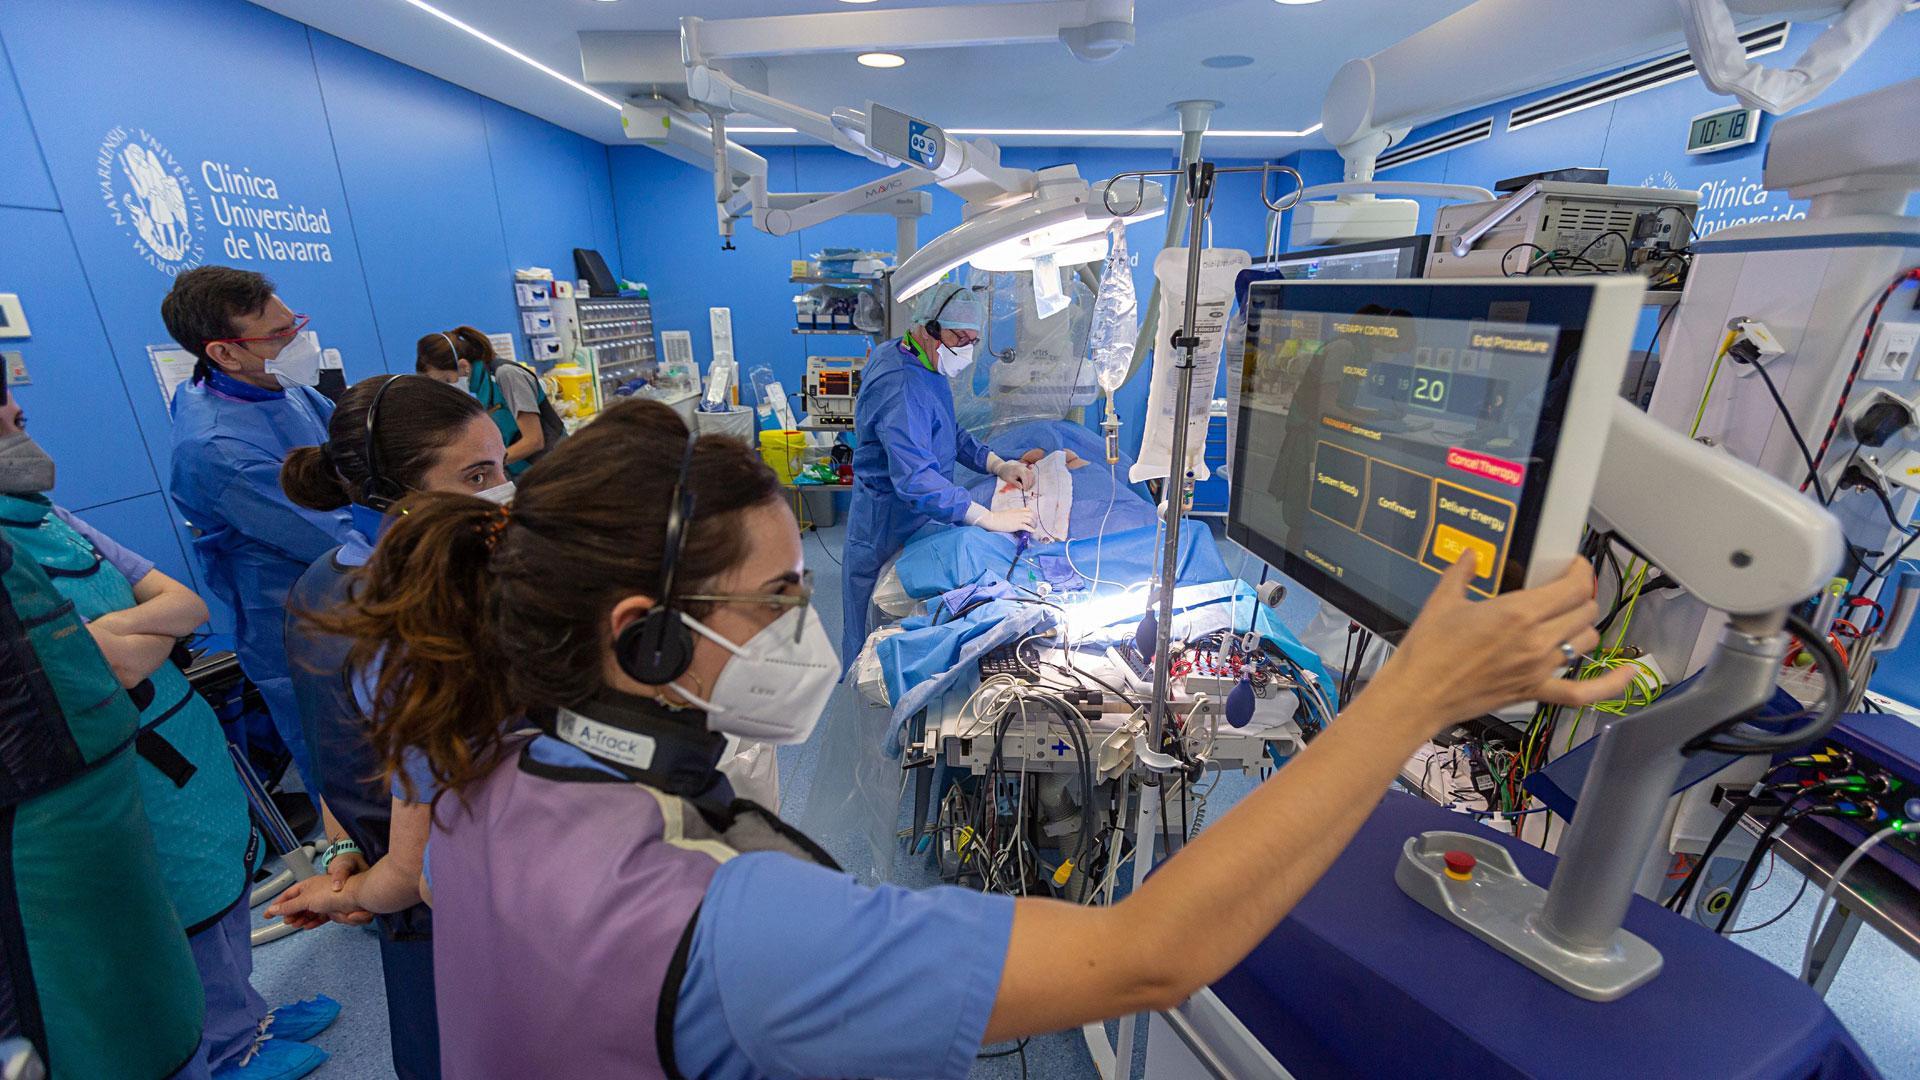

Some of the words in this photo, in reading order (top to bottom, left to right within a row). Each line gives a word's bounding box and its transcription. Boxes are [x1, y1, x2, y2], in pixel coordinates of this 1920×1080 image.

[1699, 112, 1747, 144] 10:18
[201, 160, 280, 200] Clínica
[210, 195, 332, 234] Universidad
[223, 230, 253, 260] de
[255, 231, 333, 263] Navarra
[1333, 322, 1363, 334] THERAPY
[1363, 324, 1399, 338] CONTROL
[1472, 334, 1493, 348] End
[1494, 336, 1549, 354] Procedure
[1343, 365, 1368, 378] VOLTAGE
[1317, 472, 1340, 488] System
[1447, 452, 1479, 470] Cancel
[1480, 460, 1521, 484] Therapy
[1378, 497, 1417, 520] Confirmed
[1439, 497, 1470, 517] Deliver
[1470, 508, 1506, 532] Energy
[580, 725, 638, 755] A-Track
